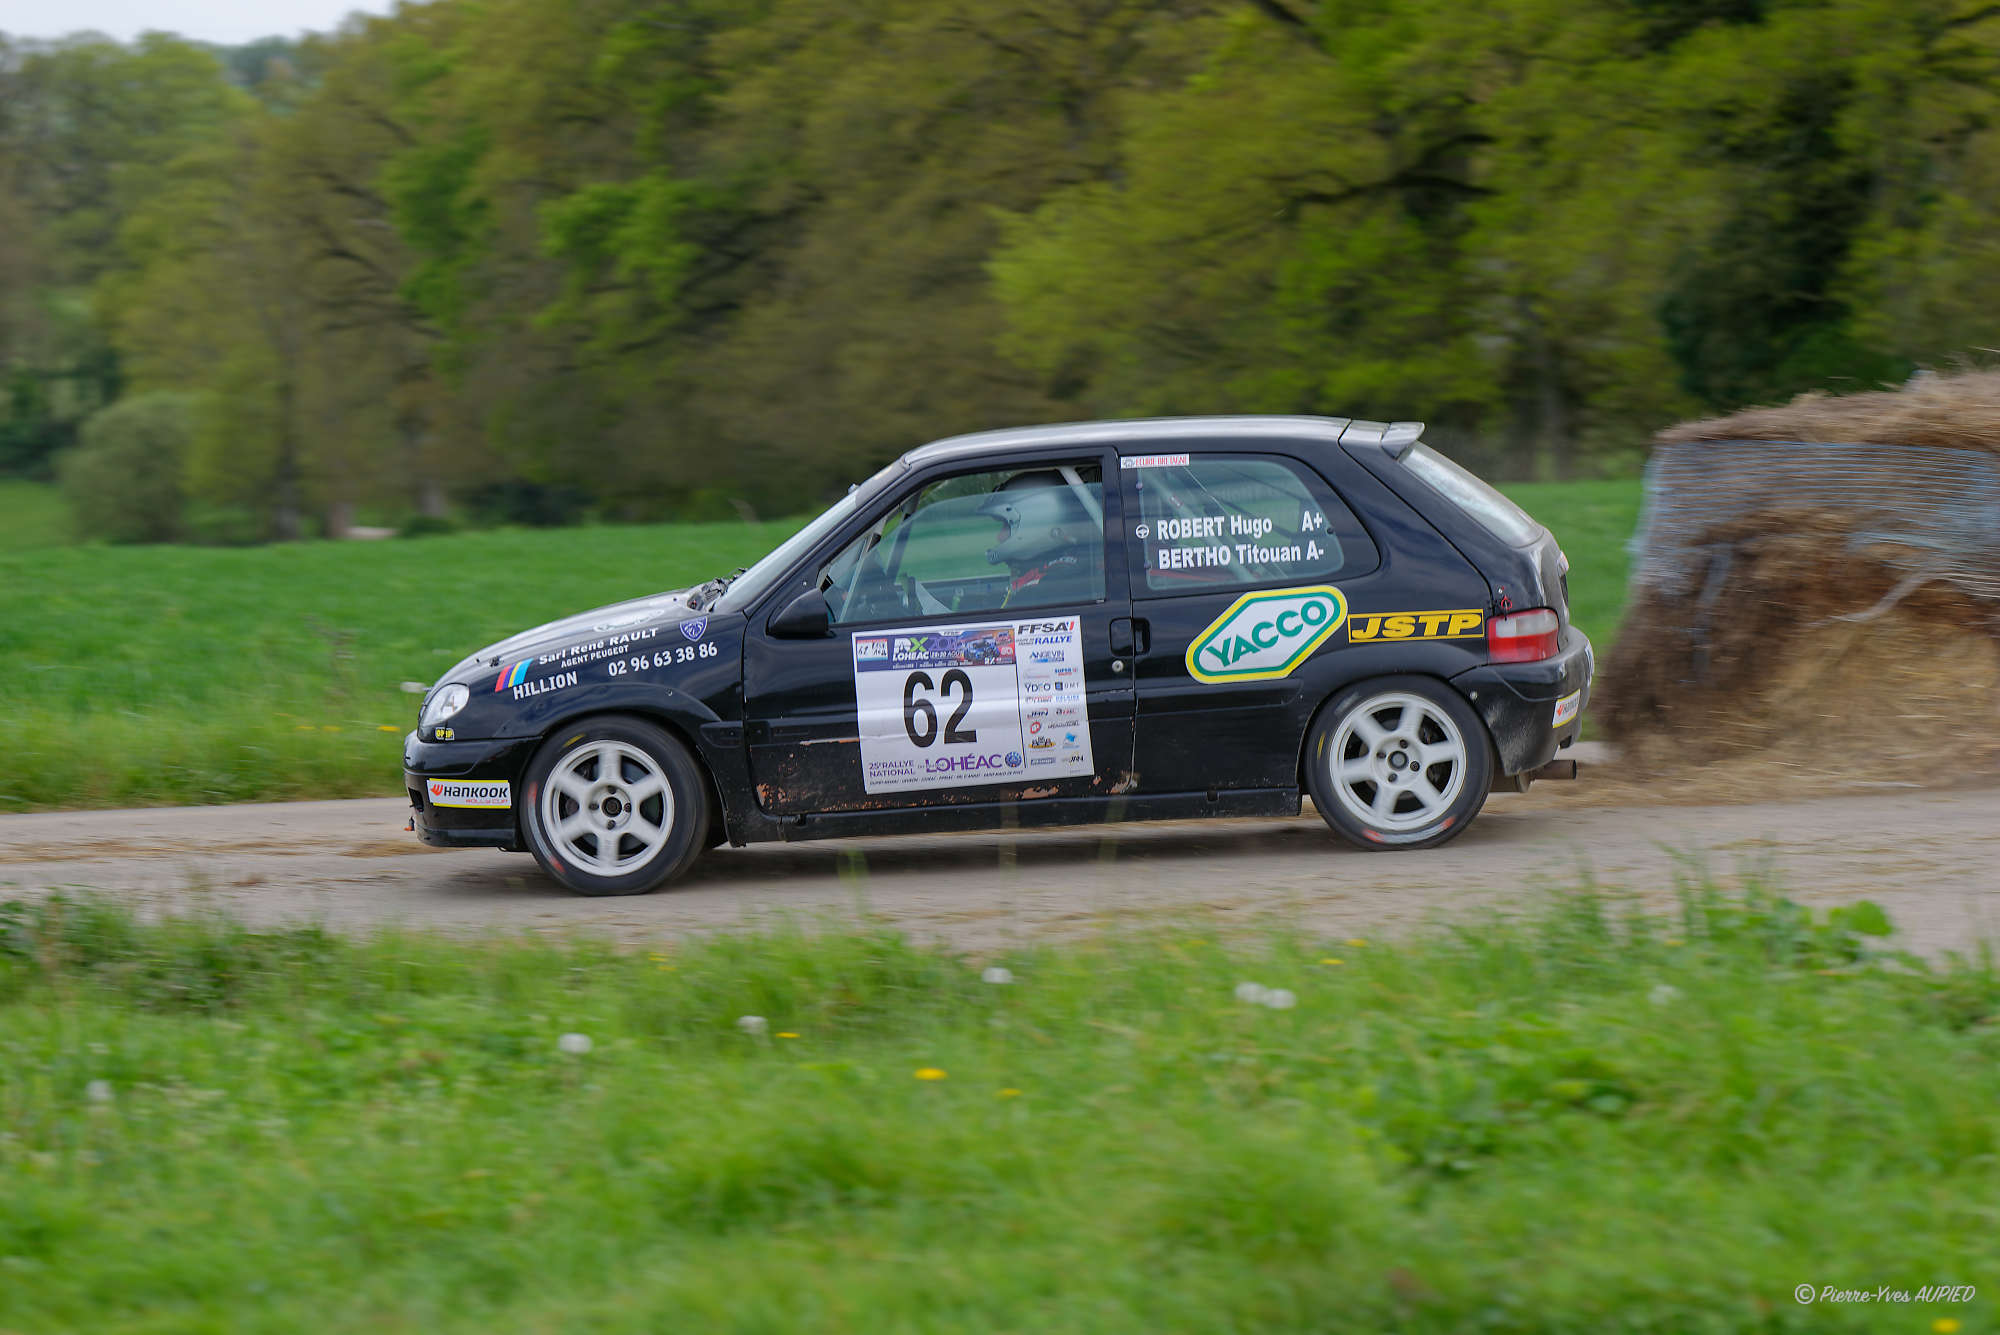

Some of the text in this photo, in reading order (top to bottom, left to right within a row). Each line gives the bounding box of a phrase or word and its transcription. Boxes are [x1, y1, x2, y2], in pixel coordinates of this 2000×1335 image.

[1157, 510, 1323, 540] ROBERT Hugo A+
[1158, 540, 1324, 570] BERTHO Titouan A-
[1018, 622, 1068, 635] FFSA
[1034, 636, 1072, 645] RALLYE
[1206, 600, 1327, 667] YACCO
[1351, 613, 1482, 639] JSTP
[539, 649, 567, 665] Sarl
[609, 628, 659, 646] RAULT
[561, 645, 629, 668] AGENT PEUGEOT
[608, 642, 718, 676] 02 96 63 38 86
[513, 671, 578, 700] HILLION
[903, 668, 977, 748] 62
[869, 768, 915, 777] NATIONAL
[925, 753, 1003, 773] LOHÉAC
